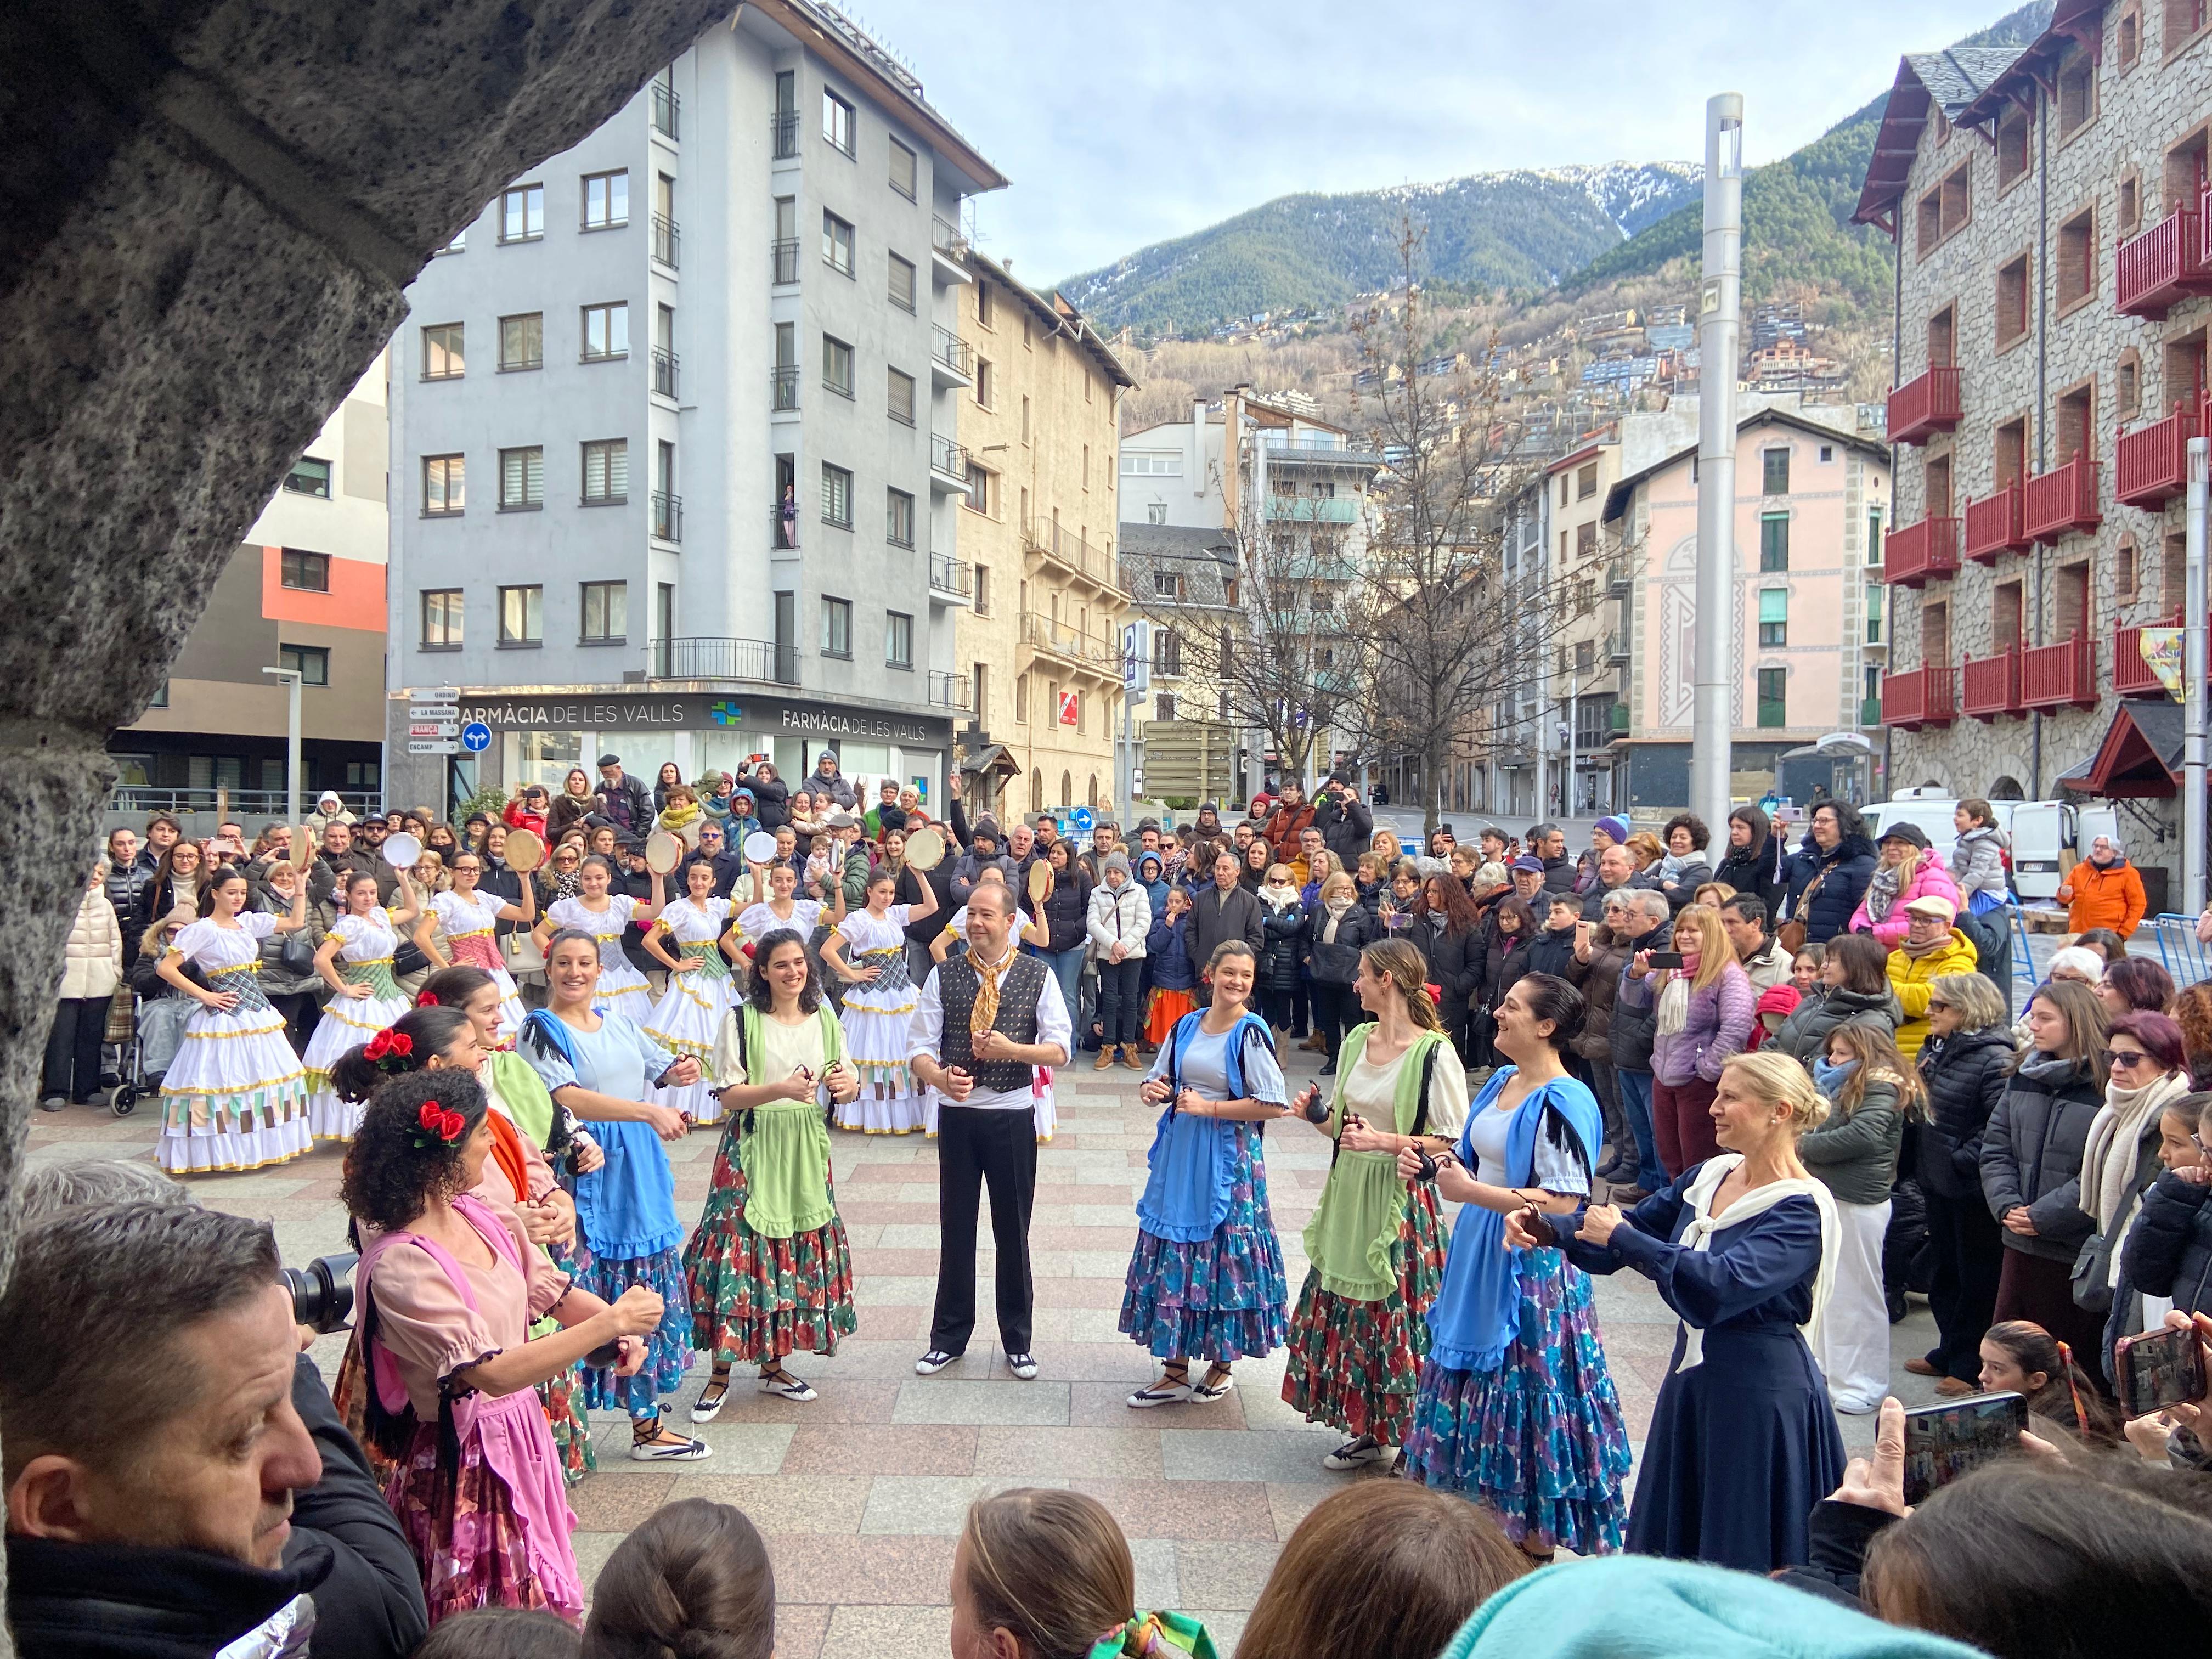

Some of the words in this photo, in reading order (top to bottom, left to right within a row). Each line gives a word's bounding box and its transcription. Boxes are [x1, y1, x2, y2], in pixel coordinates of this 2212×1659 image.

[451, 703, 549, 724] ARMÀCIA
[554, 706, 577, 723] DE
[584, 705, 617, 723] LES
[623, 704, 684, 723] VALLS
[411, 725, 438, 734] FRANÇA
[783, 710, 850, 733] FARMÀCIA
[852, 718, 867, 735] DE
[870, 720, 890, 737] LES
[893, 723, 926, 741] VALLS
